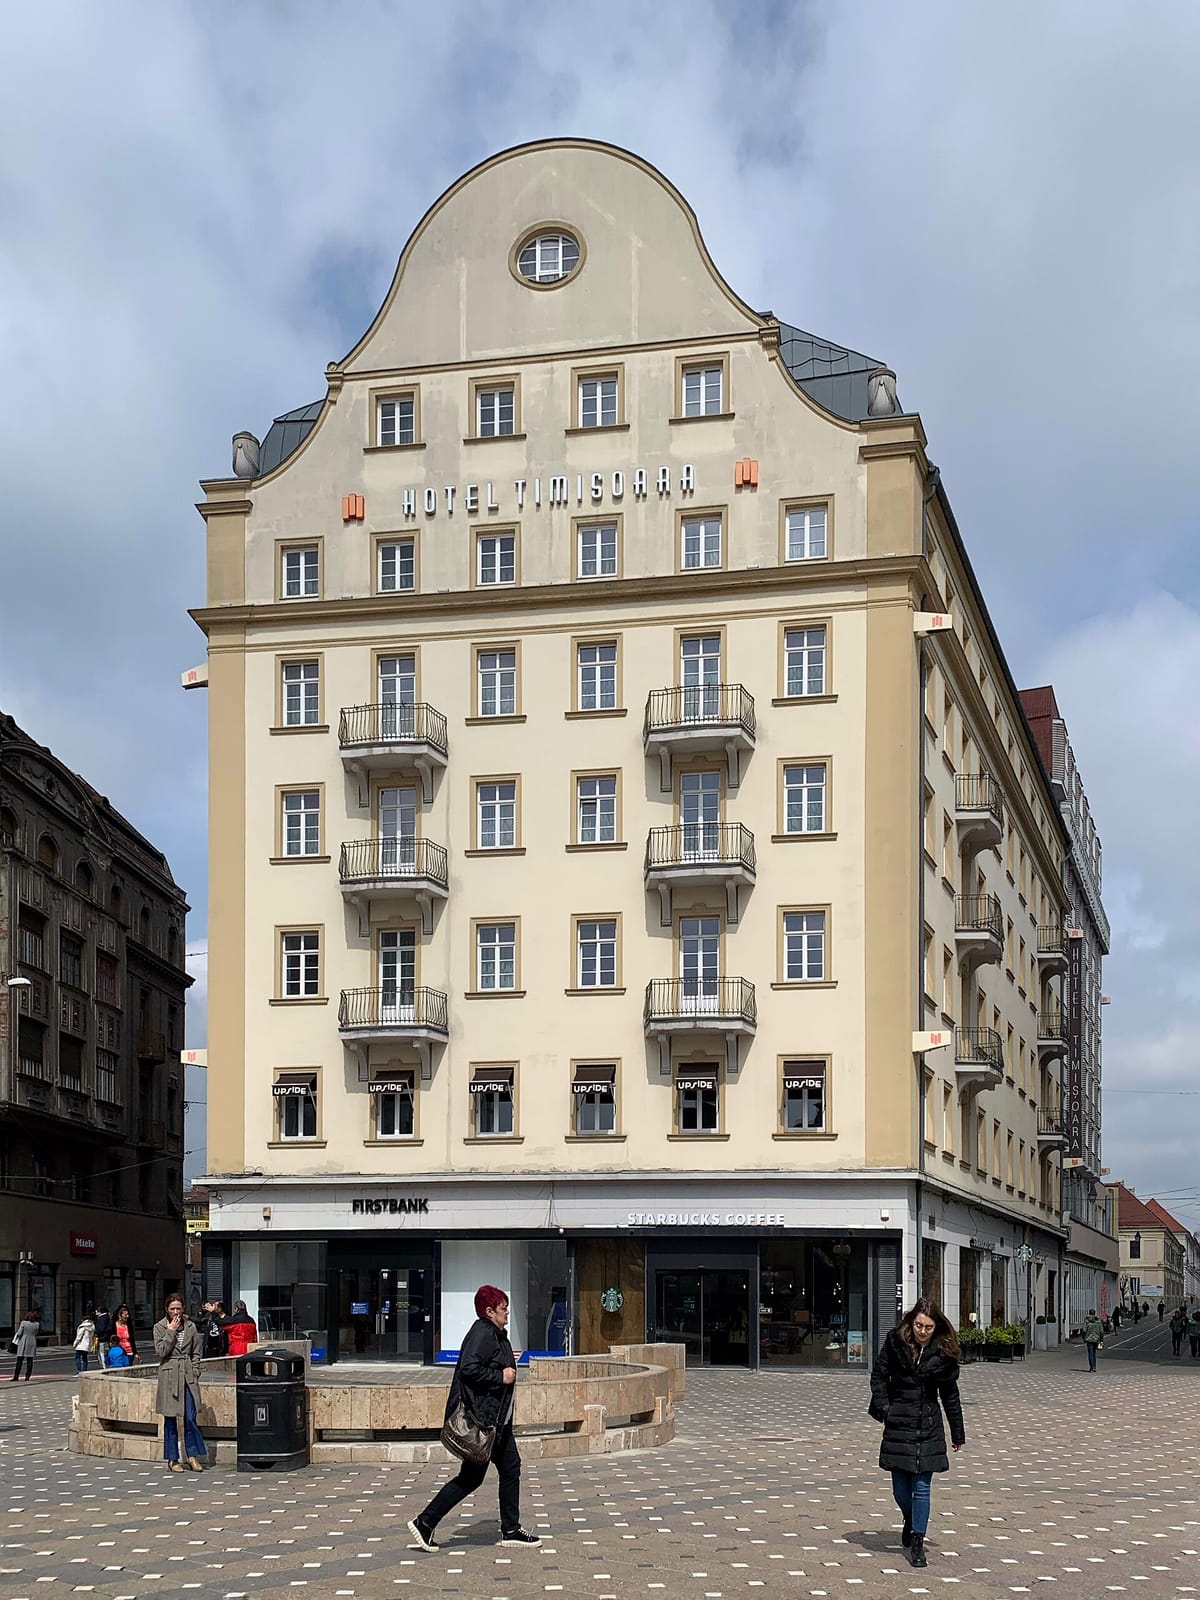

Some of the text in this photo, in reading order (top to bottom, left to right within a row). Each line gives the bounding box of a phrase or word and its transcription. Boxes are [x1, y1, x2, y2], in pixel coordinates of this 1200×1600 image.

[402, 464, 695, 516] HOTEL TIMISOARA
[369, 1083, 402, 1092] UPSIDE
[470, 1083, 504, 1092] UPSIDE
[573, 1084, 608, 1093] UPSIDE
[678, 1080, 713, 1090] UPSIDE
[785, 1079, 822, 1089] UPSIDE
[273, 1087, 307, 1096] UPSIDE
[352, 1199, 428, 1214] FIRSTBANK
[628, 1212, 785, 1226] STARBUCKS COFFEE
[75, 1238, 95, 1248] Miele
